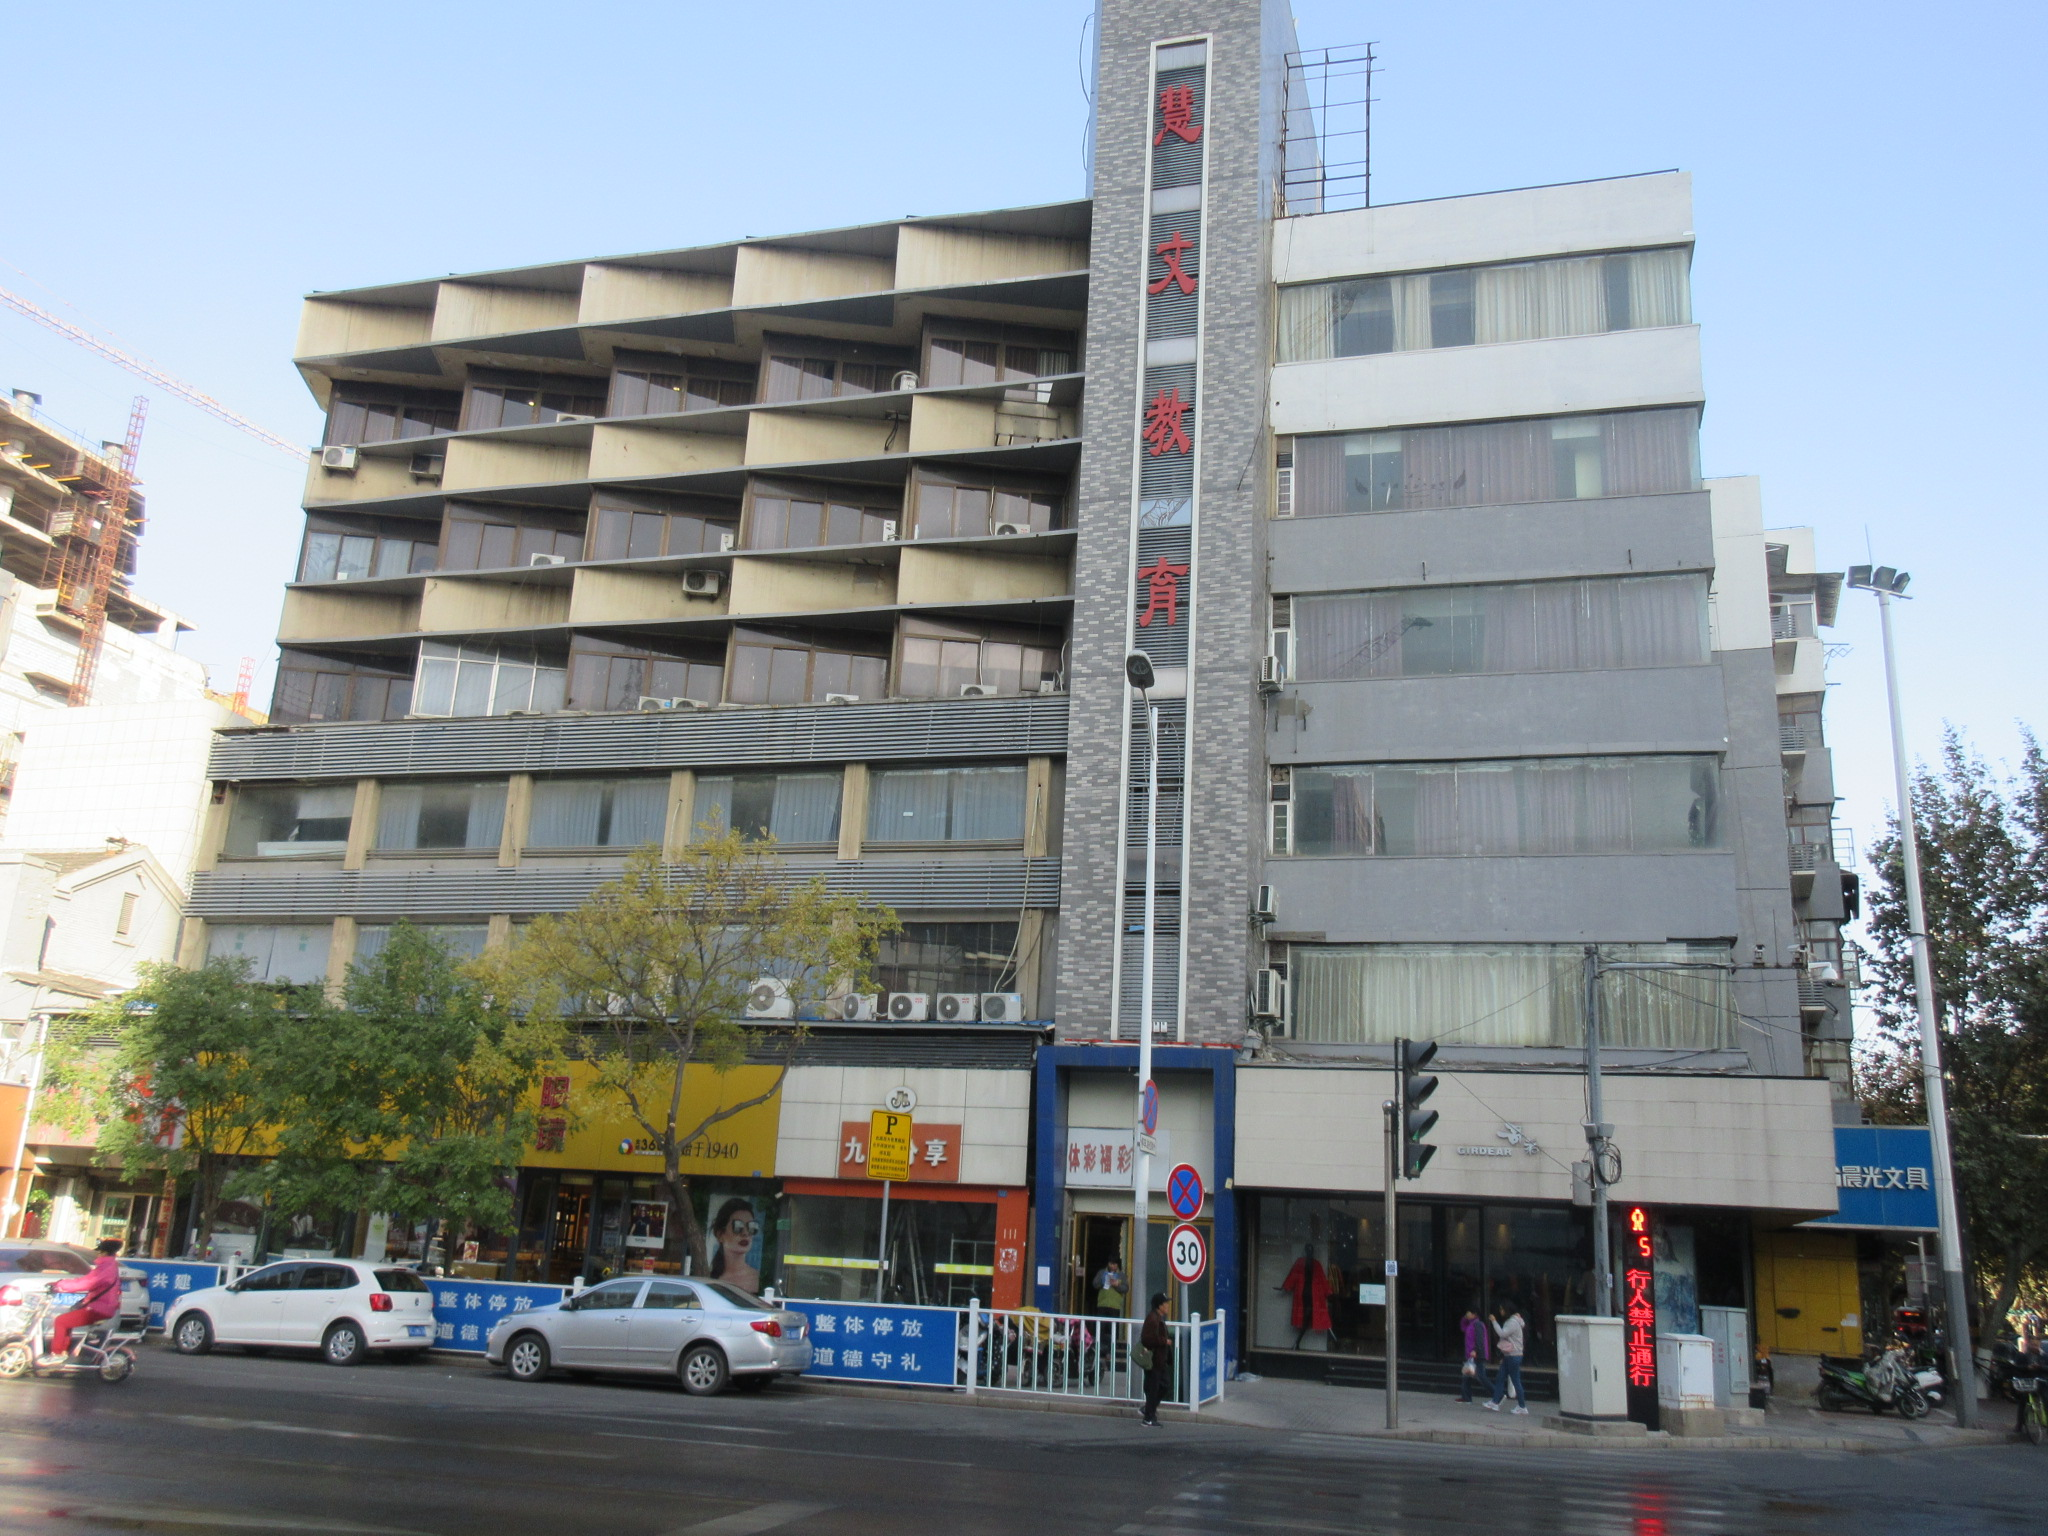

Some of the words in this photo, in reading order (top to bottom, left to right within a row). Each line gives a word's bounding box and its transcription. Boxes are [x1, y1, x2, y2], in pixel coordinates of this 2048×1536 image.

[885, 1115, 898, 1135] P
[1456, 1145, 1513, 1157] GIRDEAR
[1176, 1241, 1199, 1266] 30
[439, 1291, 533, 1312] 整体停放
[814, 1313, 924, 1338] 整体停放
[1626, 1268, 1656, 1387] 行人禁止通行
[813, 1347, 922, 1372] 道德守礼
